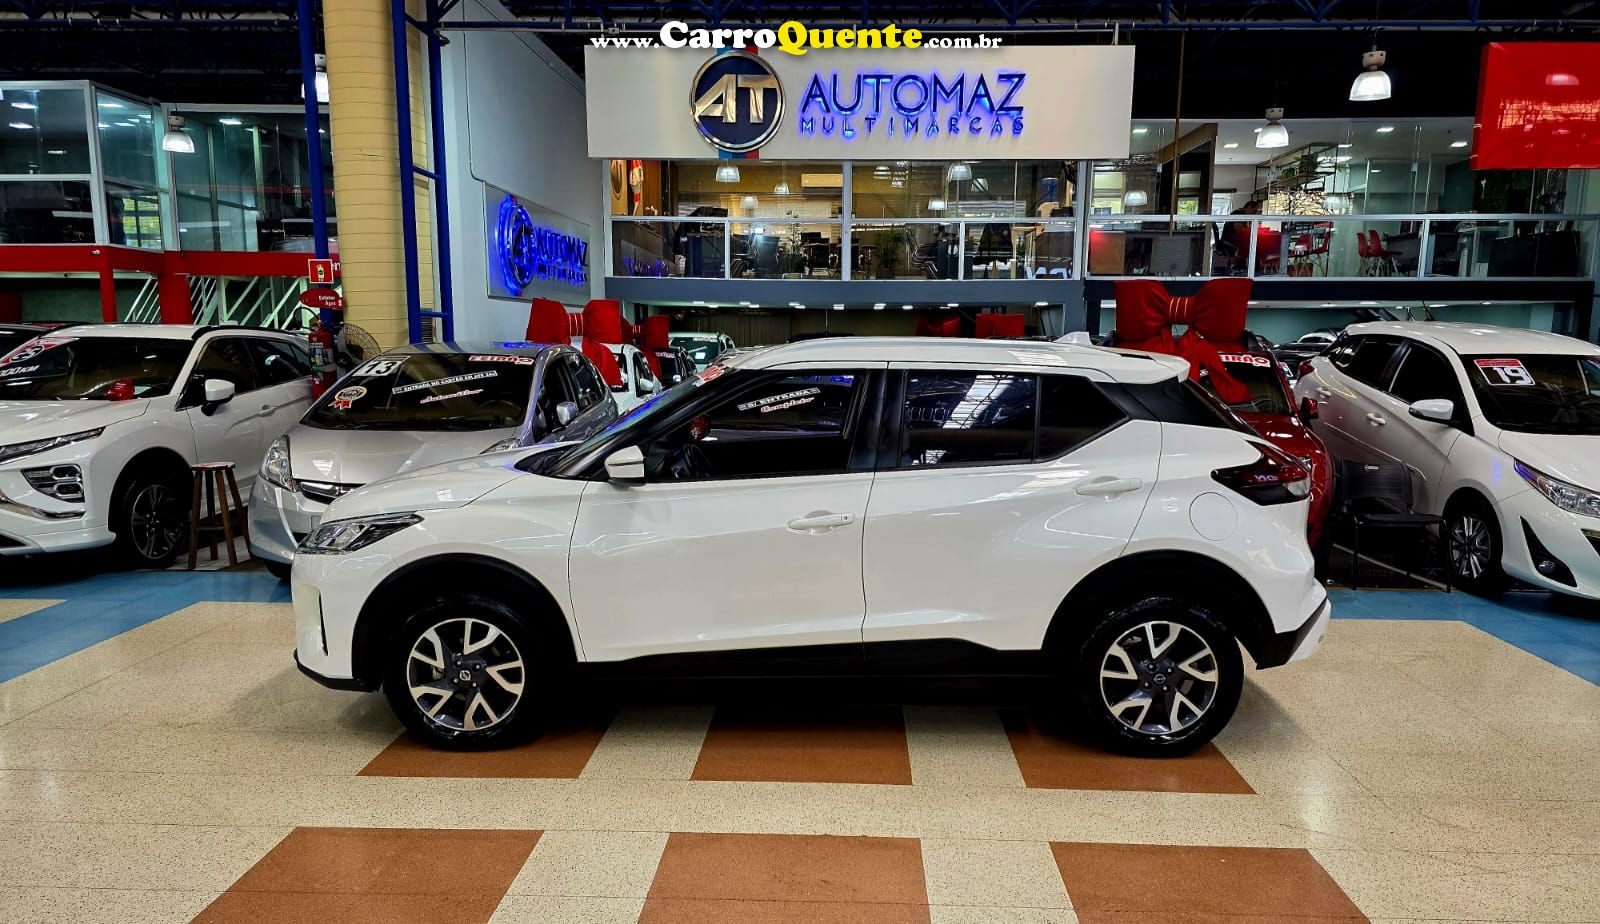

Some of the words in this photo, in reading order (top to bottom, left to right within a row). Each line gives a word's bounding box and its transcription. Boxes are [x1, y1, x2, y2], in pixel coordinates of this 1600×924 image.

[694, 74, 778, 123] AT
[801, 73, 1026, 114] AUTOMAZ
[801, 116, 1024, 135] MULTIMARCAS
[365, 361, 398, 374] 13
[1492, 367, 1531, 384] 19
